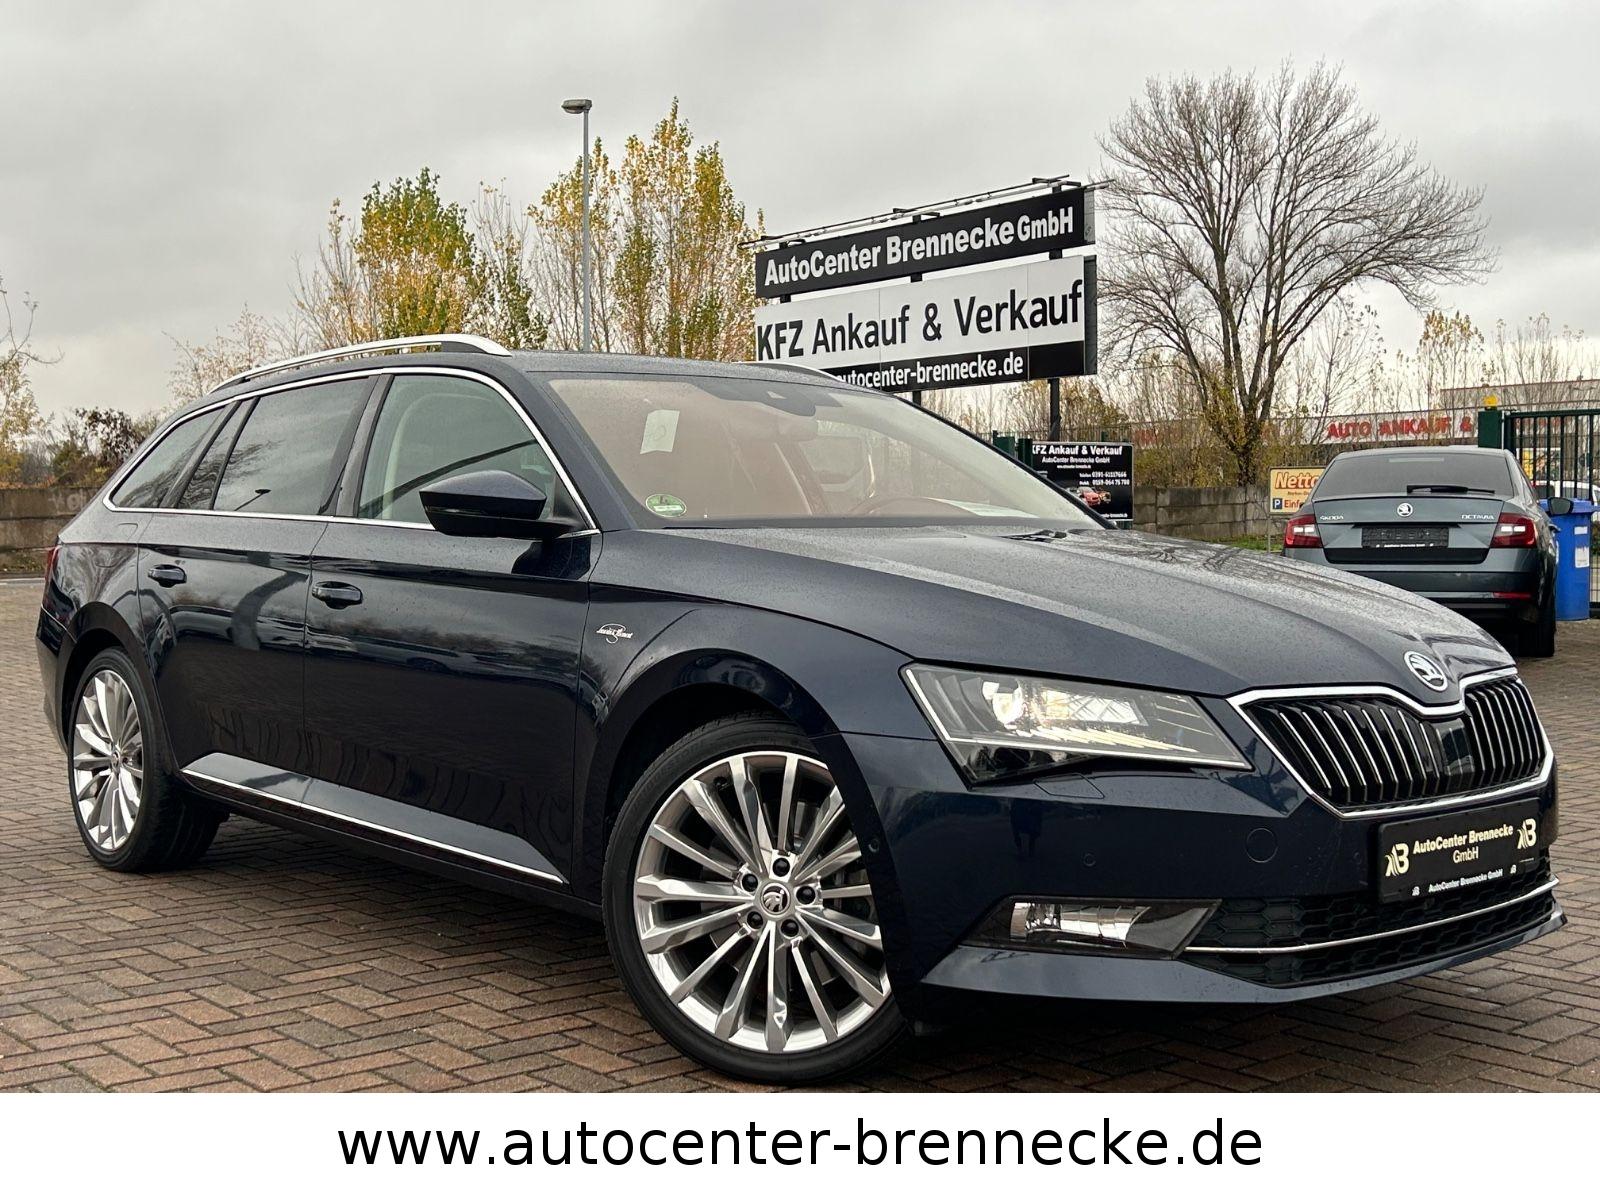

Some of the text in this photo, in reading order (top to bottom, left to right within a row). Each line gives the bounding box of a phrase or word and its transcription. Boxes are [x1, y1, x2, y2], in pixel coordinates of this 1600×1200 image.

[764, 206, 1074, 287] AutoCenter Brennecke GmbH
[757, 279, 1083, 361] KFZ Ankauf & Verkauf
[1328, 420, 1371, 438] AUTO
[1048, 444, 1079, 455] Ankauf
[1081, 445, 1088, 455] &
[1090, 445, 1122, 455] Verkauf
[1413, 824, 1513, 854] AutoCenter Brennecke
[1453, 847, 1479, 863] GmbH
[1428, 881, 1459, 893] AutoCenter
